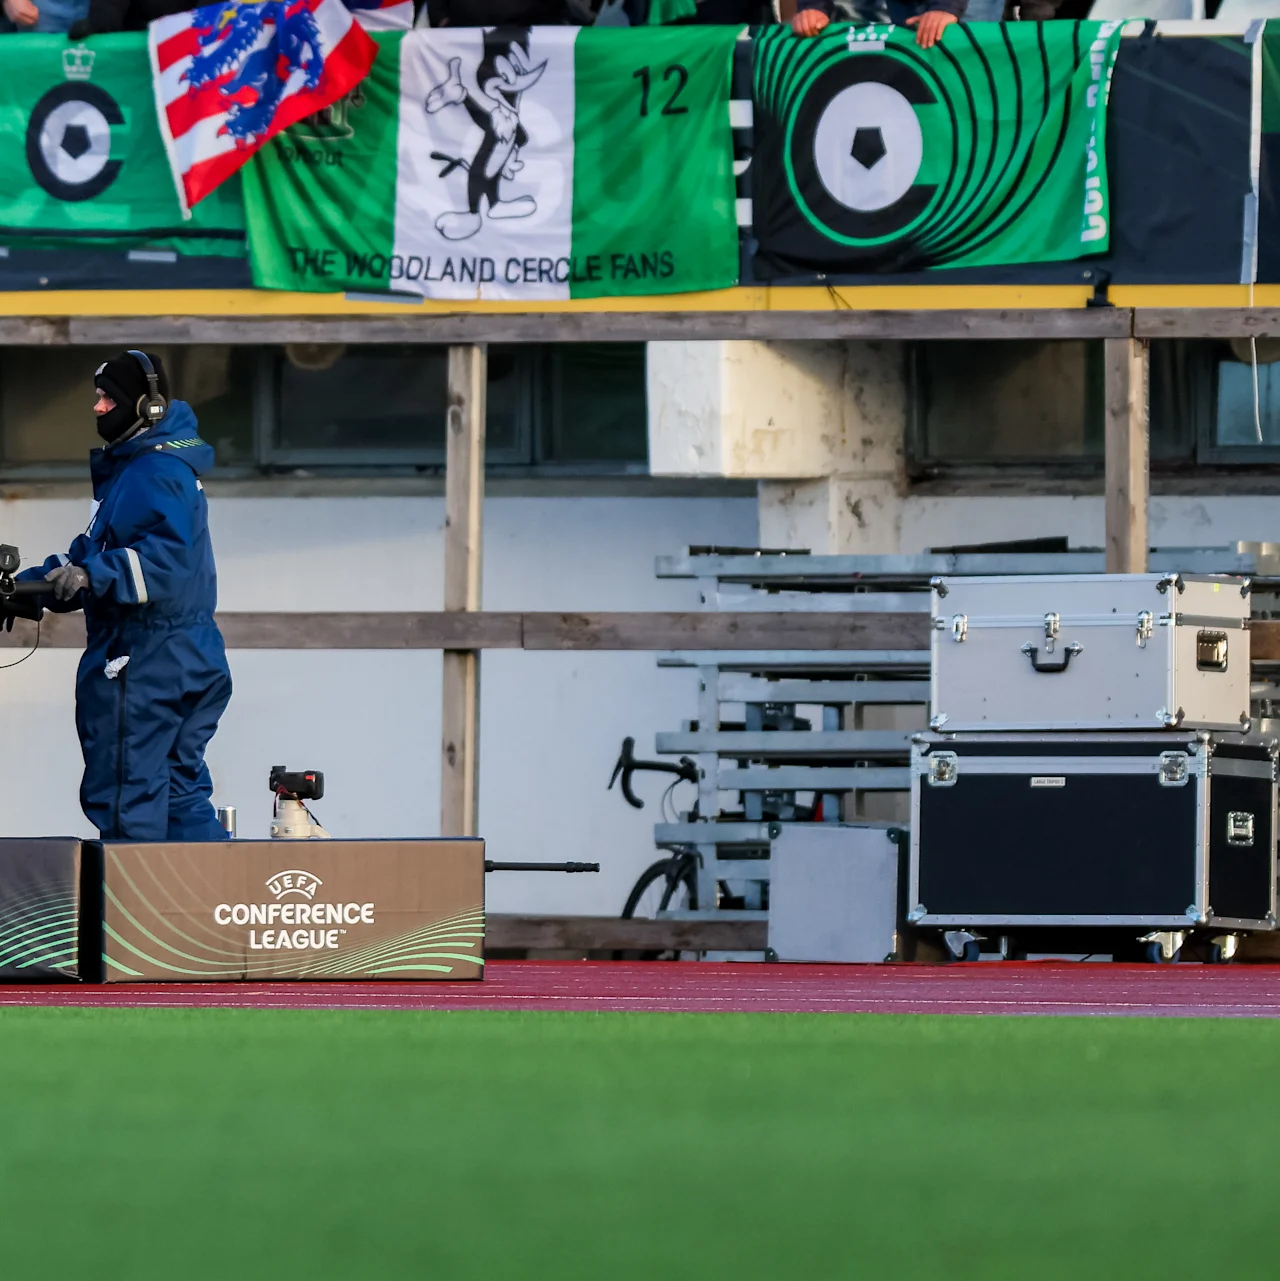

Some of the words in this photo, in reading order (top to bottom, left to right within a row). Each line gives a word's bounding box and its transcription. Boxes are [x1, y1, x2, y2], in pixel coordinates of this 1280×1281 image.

[633, 64, 689, 117] 12
[288, 246, 337, 278] THE
[346, 252, 495, 282] WOODLAND
[505, 256, 603, 283] CERCLE
[609, 250, 675, 279] FANS
[269, 875, 318, 896] UEFA
[214, 903, 375, 925] CONFERENCE
